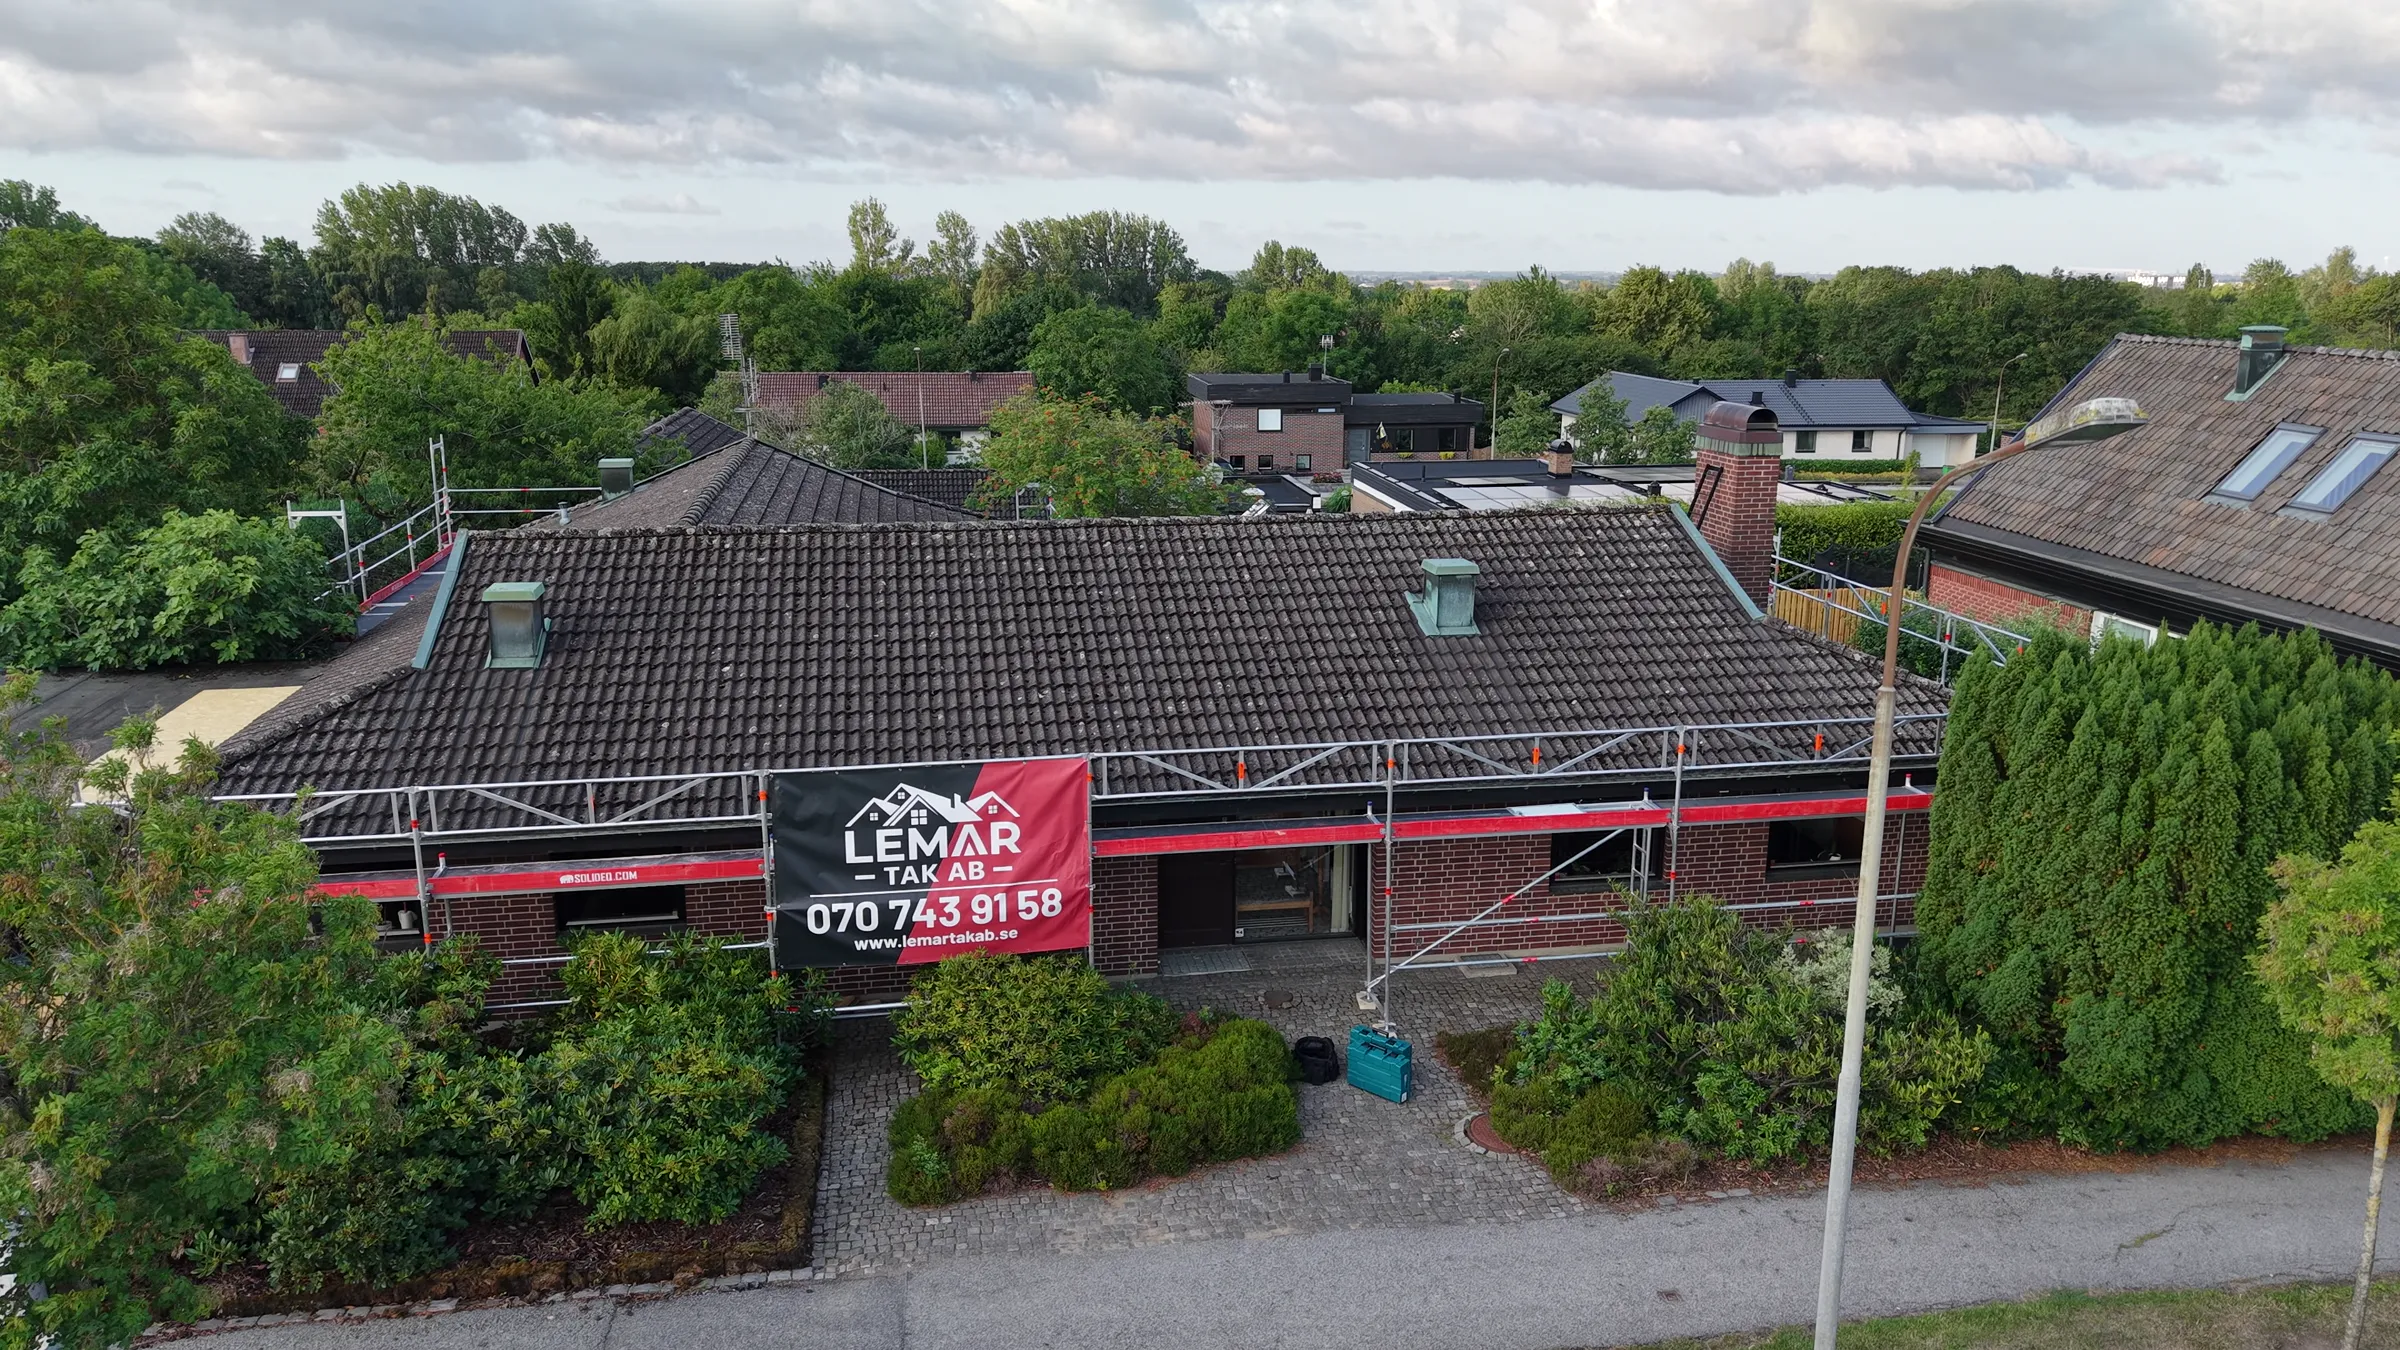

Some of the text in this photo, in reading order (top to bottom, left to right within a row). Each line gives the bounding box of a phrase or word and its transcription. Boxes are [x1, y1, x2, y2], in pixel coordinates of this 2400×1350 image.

[845, 821, 1021, 864] LEMAR
[884, 861, 985, 886] TAK AB
[806, 888, 1062, 935] 070 743 91 58
[854, 928, 1018, 951] www.lemartakab.se
